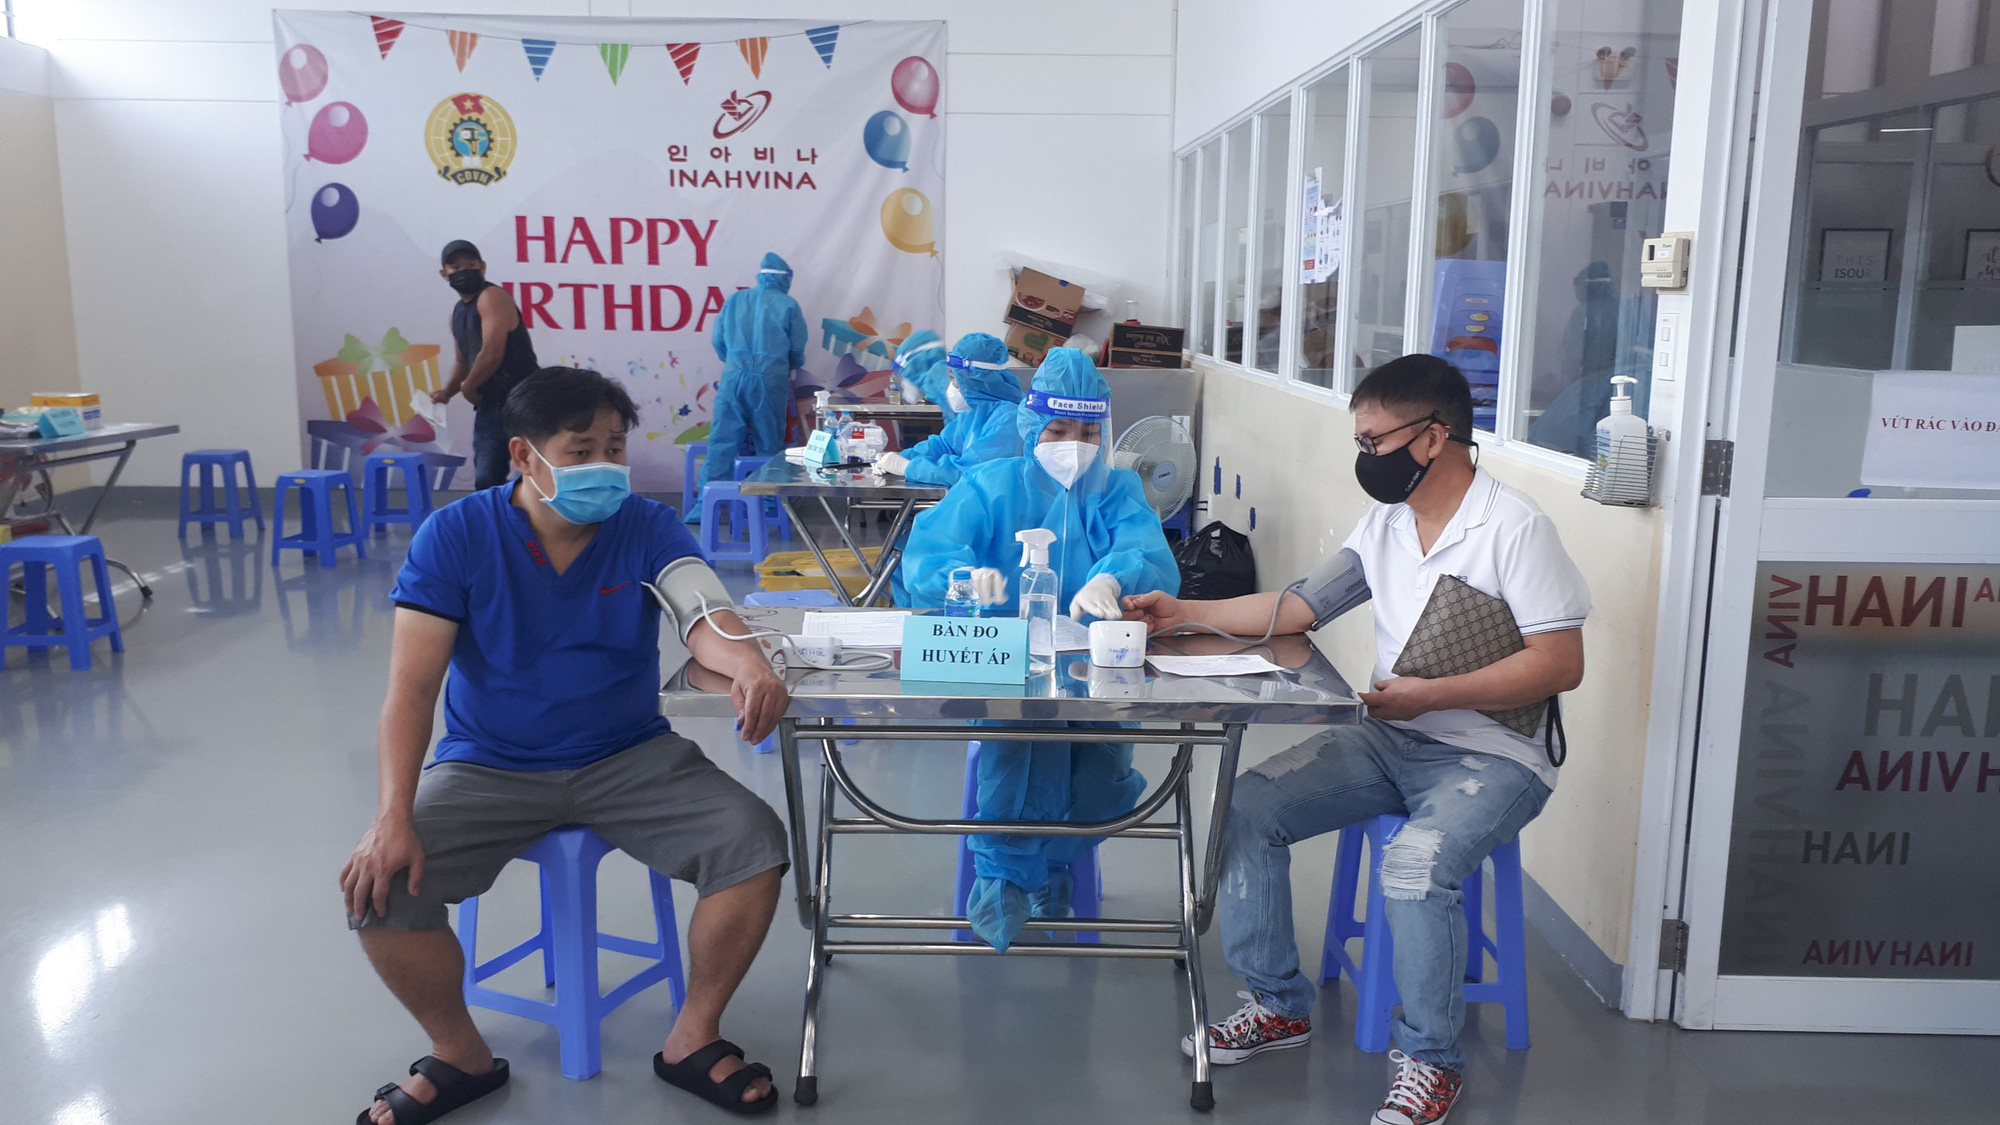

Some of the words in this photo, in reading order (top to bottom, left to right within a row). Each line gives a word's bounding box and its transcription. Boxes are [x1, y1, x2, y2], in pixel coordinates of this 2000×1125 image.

[669, 169, 817, 190] INAHVINA
[514, 215, 720, 267] HAPPY
[501, 281, 752, 333] RTHDA
[1052, 400, 1074, 409] Face
[1077, 402, 1103, 411] Shield
[1881, 415, 1912, 429] VỨT
[1915, 416, 1947, 430] RÁC
[1951, 417, 1982, 432] VÀO
[932, 621, 968, 637] BÀN
[973, 625, 999, 639] ĐO
[921, 647, 983, 664] HUYẾT
[987, 648, 1011, 665] ÁP
